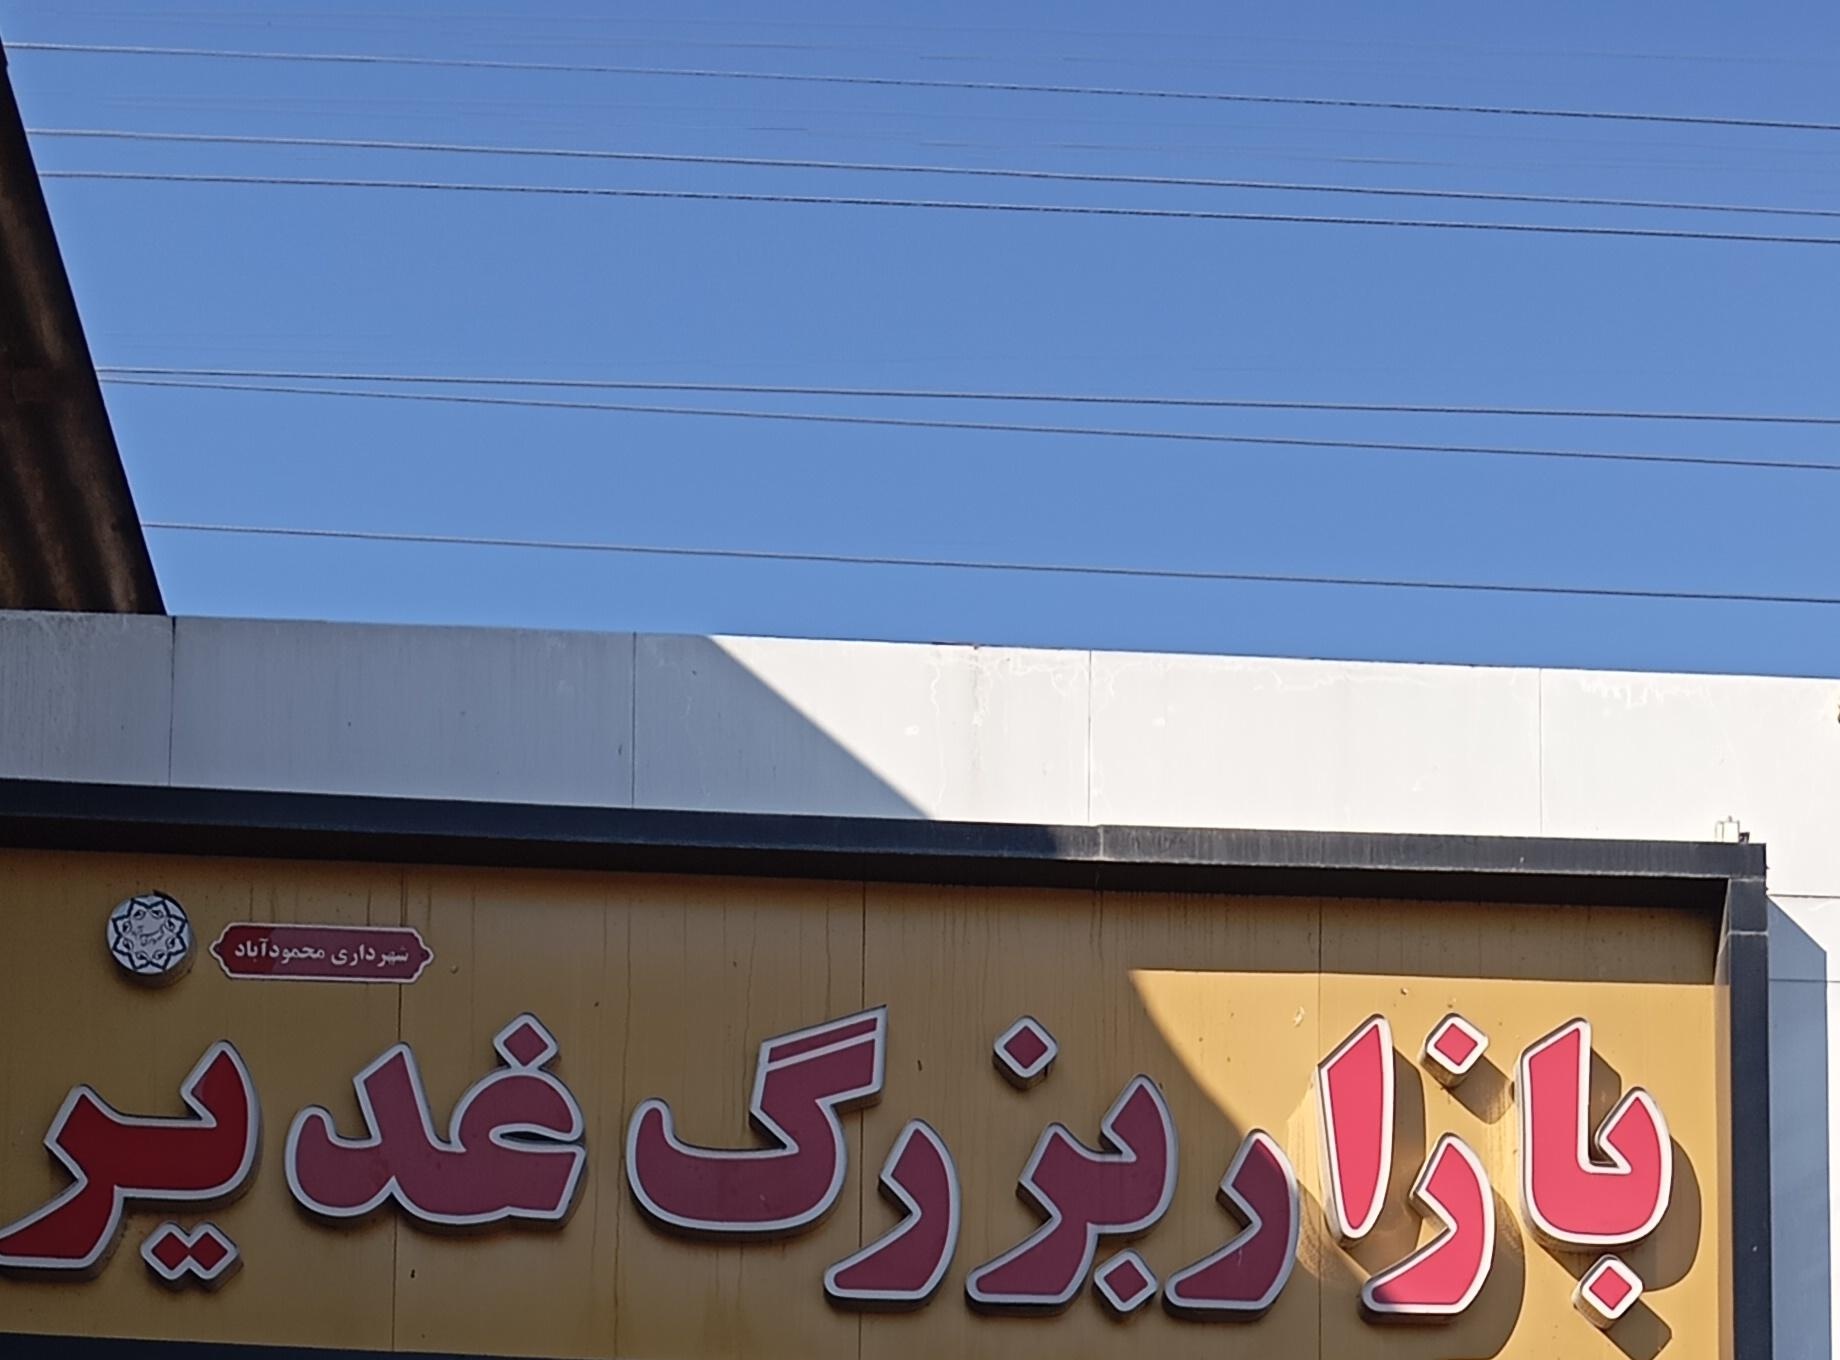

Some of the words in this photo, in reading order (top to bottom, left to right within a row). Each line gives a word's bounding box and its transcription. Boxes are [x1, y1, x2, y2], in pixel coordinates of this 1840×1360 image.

[0, 1011, 588, 1286] غدیر
[625, 1004, 1181, 1318] بزرگ
[1164, 1012, 1674, 1328] بازار
